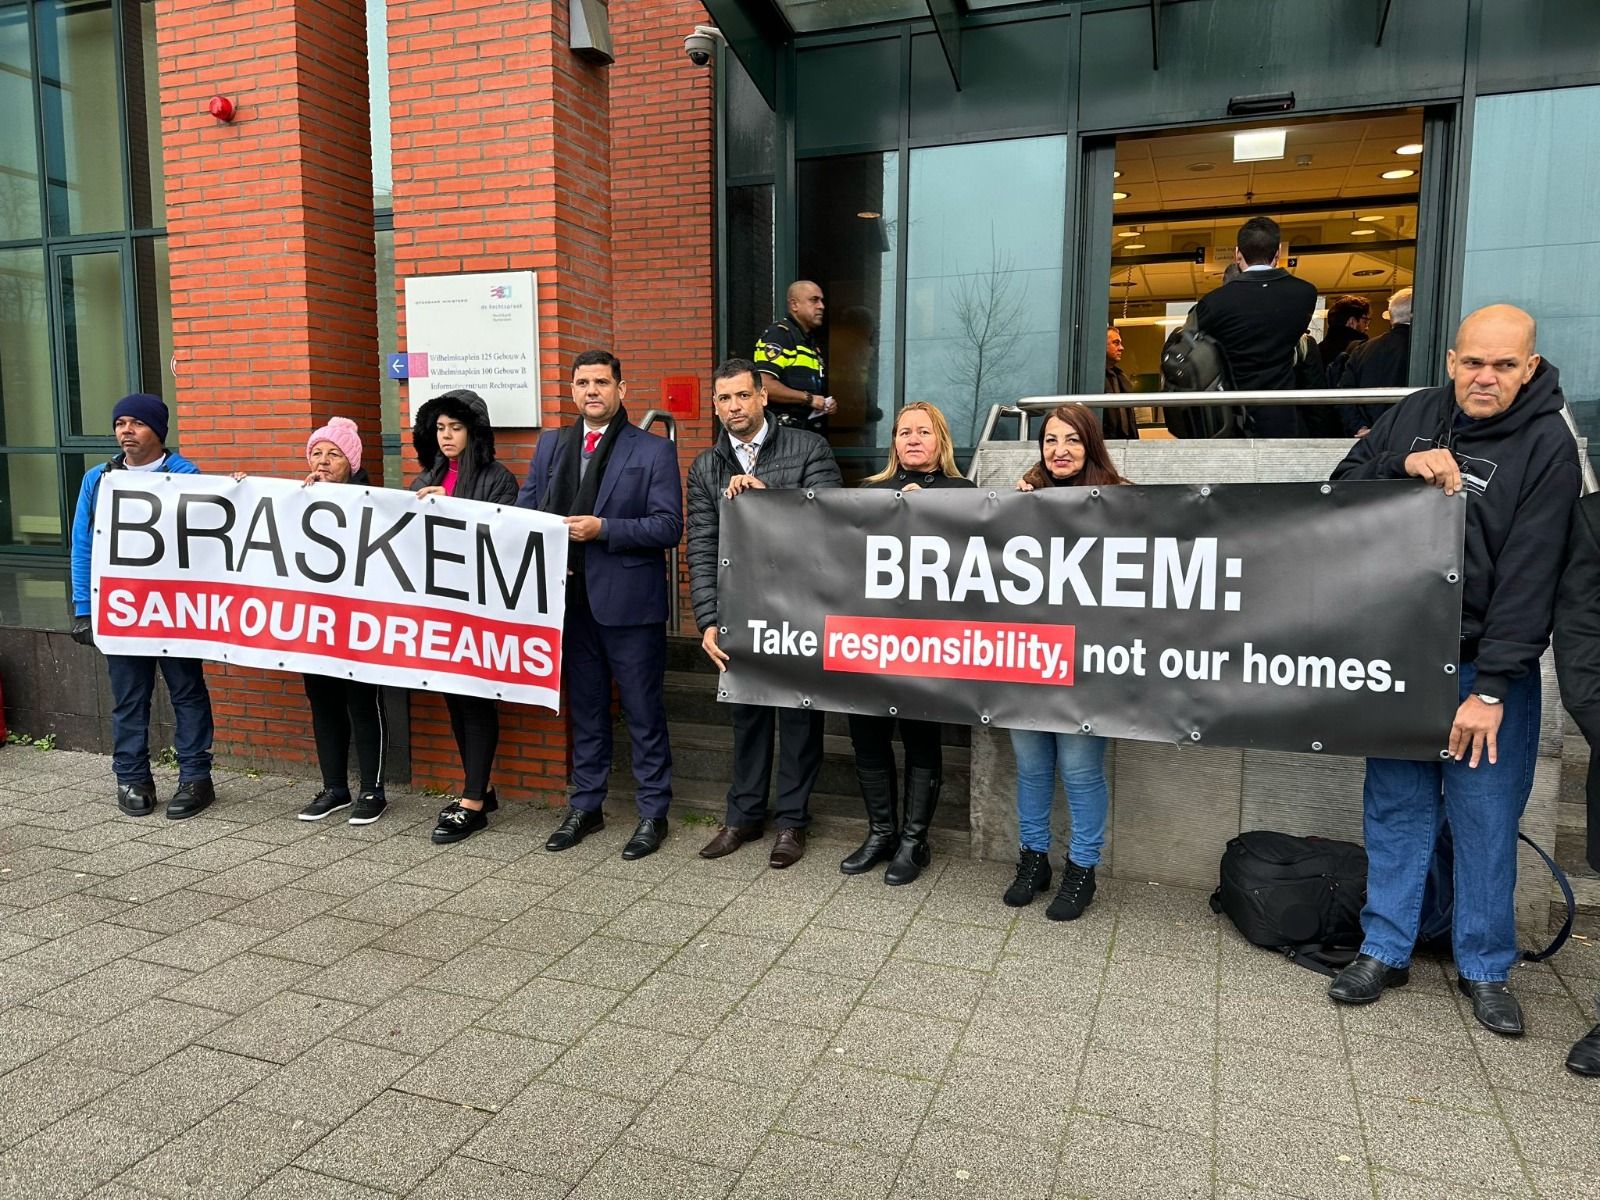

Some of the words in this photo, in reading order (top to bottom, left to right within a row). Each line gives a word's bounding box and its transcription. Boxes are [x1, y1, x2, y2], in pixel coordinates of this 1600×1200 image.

[430, 354, 480, 363] Wilhelminaplein
[493, 352, 519, 360] Gebouw
[520, 352, 526, 360] A
[489, 381, 528, 390] Rechtspraak
[109, 489, 548, 614] BRASKEM
[864, 534, 1242, 612] BRASKEM:
[106, 588, 234, 634] SANK
[239, 597, 336, 646] OUR
[348, 611, 554, 677] DREAMS
[747, 619, 818, 656] Take
[828, 630, 1069, 680] responsibility,
[1082, 635, 1147, 677] not
[1159, 647, 1230, 681] our
[1242, 642, 1407, 693] homes.
